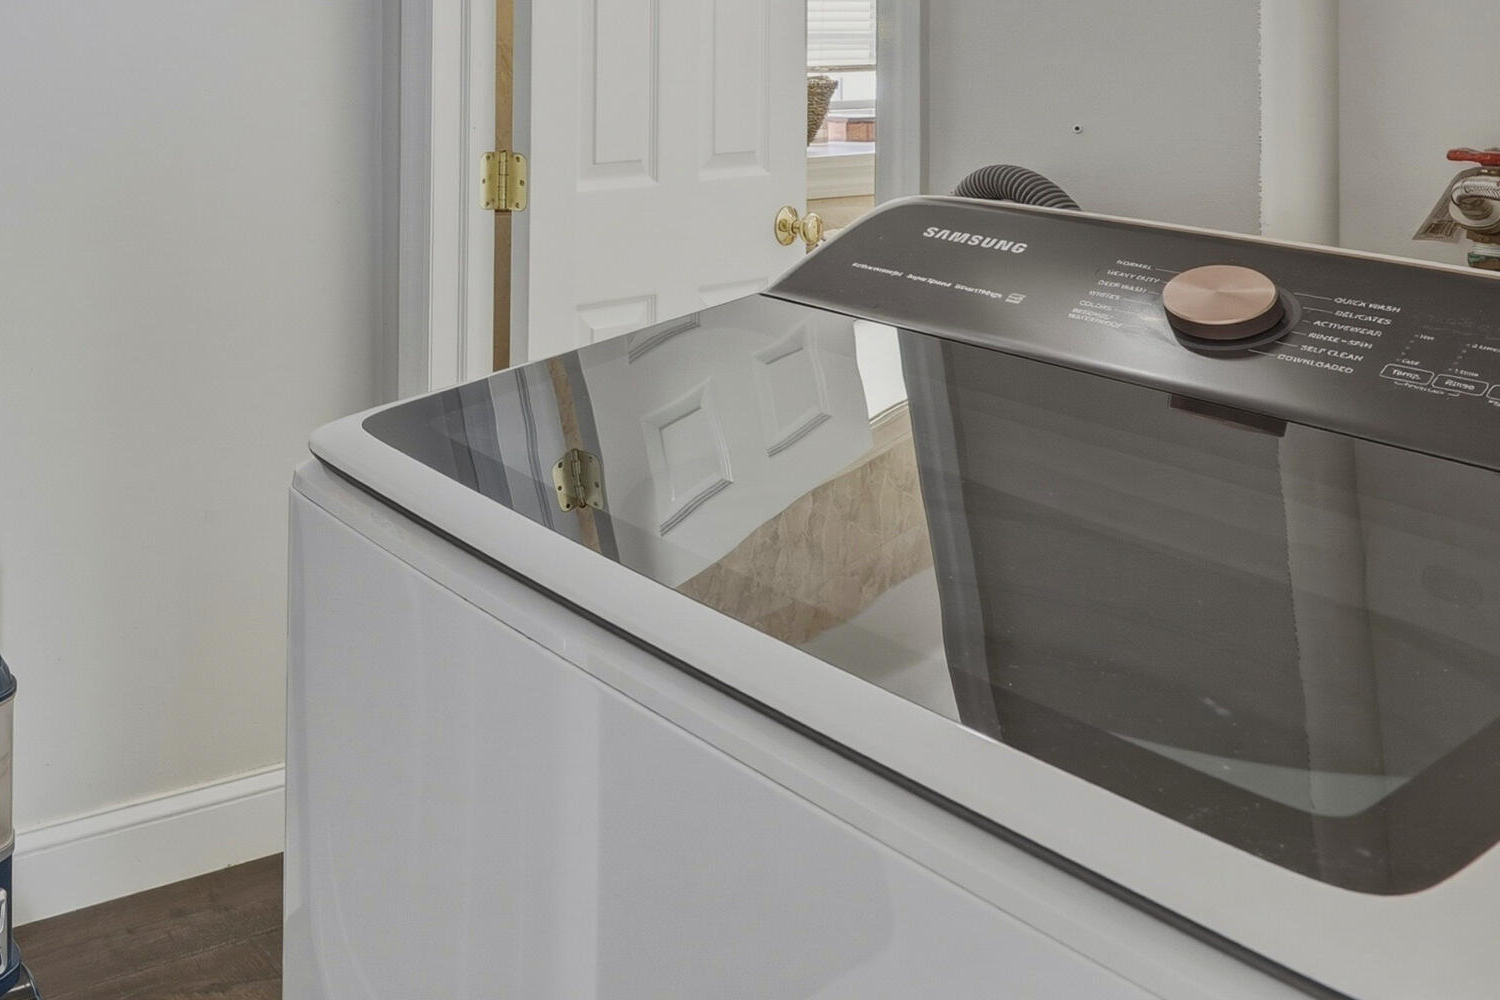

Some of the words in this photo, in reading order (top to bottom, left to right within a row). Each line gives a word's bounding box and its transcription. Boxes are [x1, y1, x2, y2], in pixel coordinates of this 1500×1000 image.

[922, 226, 1028, 254] SAMSUNG
[1334, 297, 1368, 308] QUICK
[1368, 302, 1401, 313] WASH
[1335, 310, 1392, 326] DELICATES
[1313, 320, 1382, 338] ACTIVEWEAR
[1307, 331, 1341, 343] RINSE
[1347, 339, 1373, 349] SPIN
[1300, 344, 1326, 354] SELF
[1327, 350, 1364, 362] CLEAN
[1277, 353, 1354, 374] DOWNLOADED
